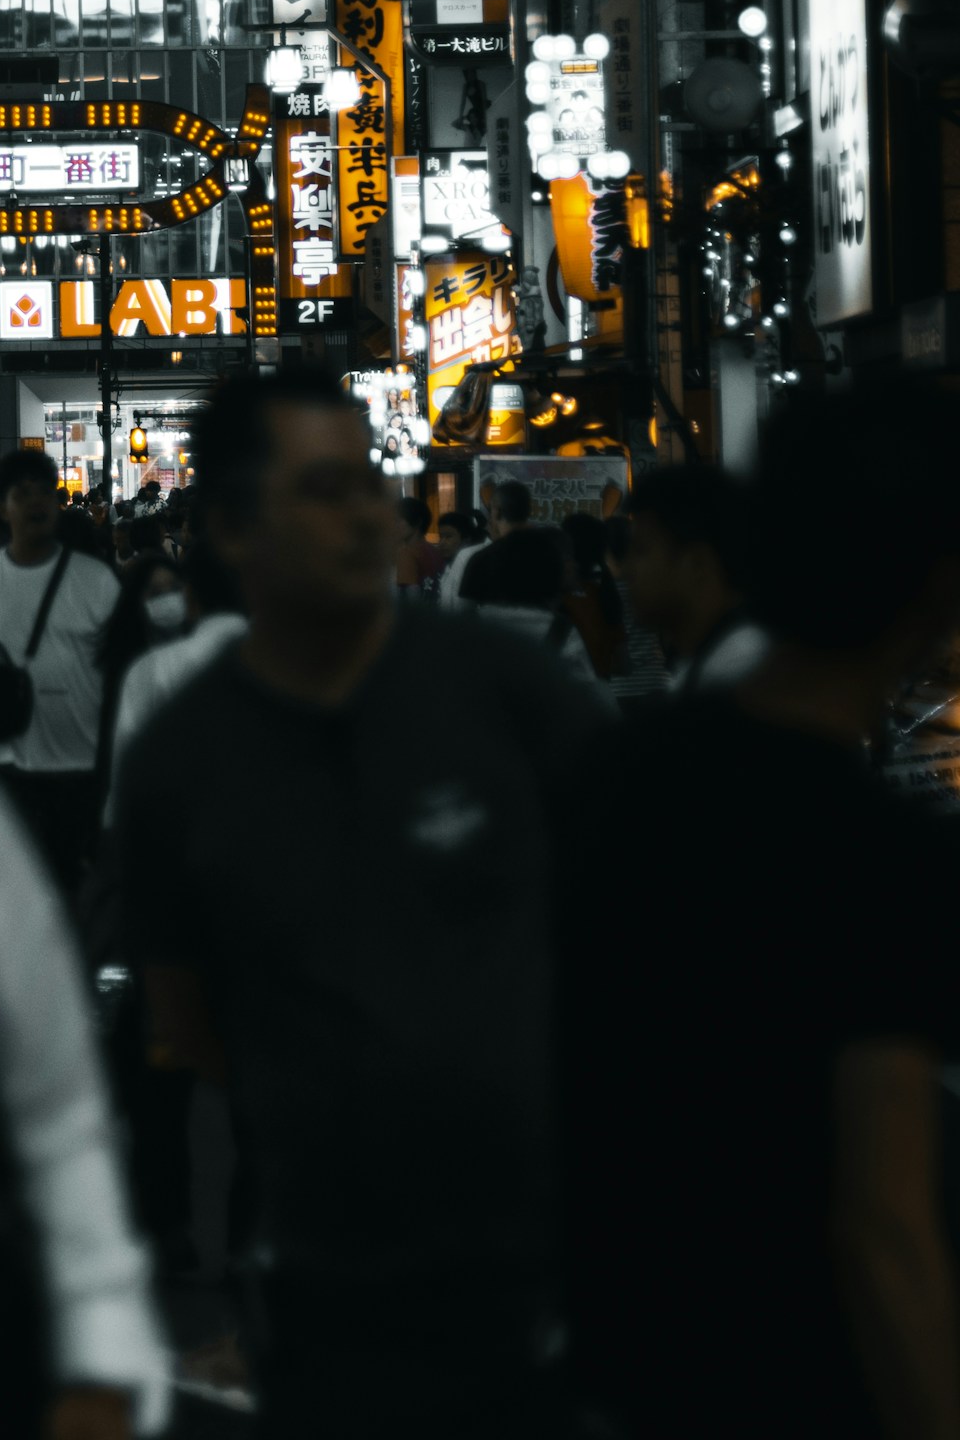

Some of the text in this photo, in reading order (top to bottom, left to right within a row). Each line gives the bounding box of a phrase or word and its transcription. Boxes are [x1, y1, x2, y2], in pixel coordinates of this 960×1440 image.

[423, 36, 509, 54] 第一大滝ビル
[297, 301, 335, 324] 2F
